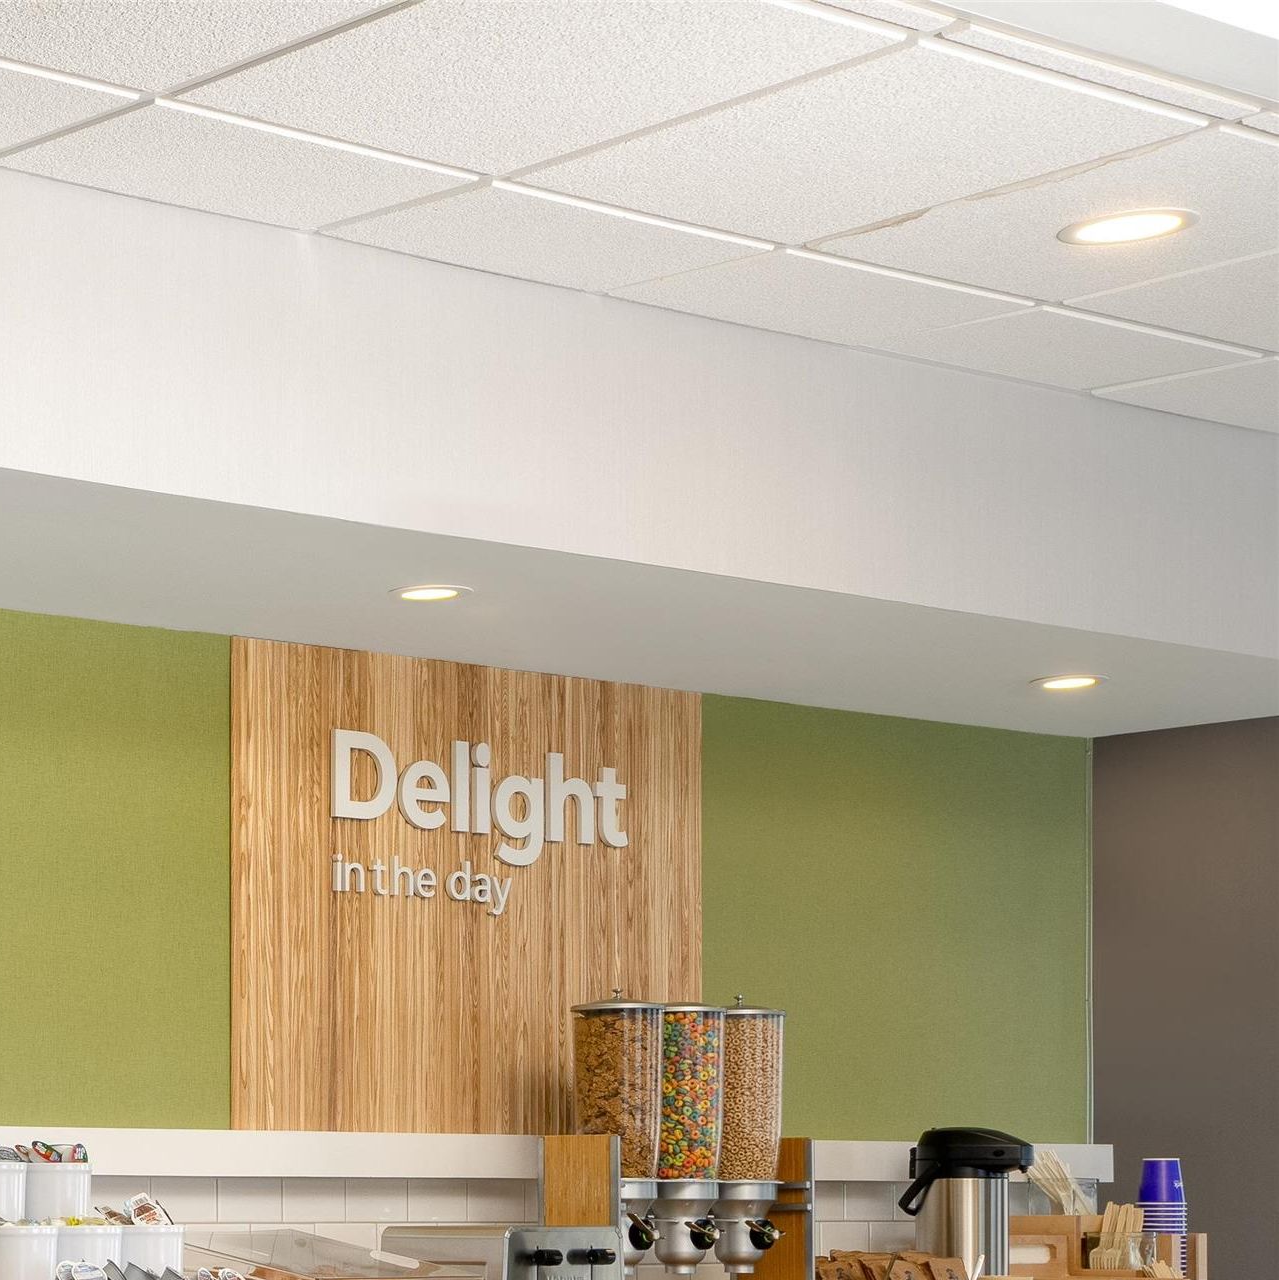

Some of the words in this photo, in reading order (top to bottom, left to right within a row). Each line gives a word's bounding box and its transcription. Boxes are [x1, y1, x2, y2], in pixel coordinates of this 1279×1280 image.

[330, 727, 629, 867] Delight
[331, 852, 365, 893] in
[368, 855, 437, 898] the
[445, 859, 513, 917] day
